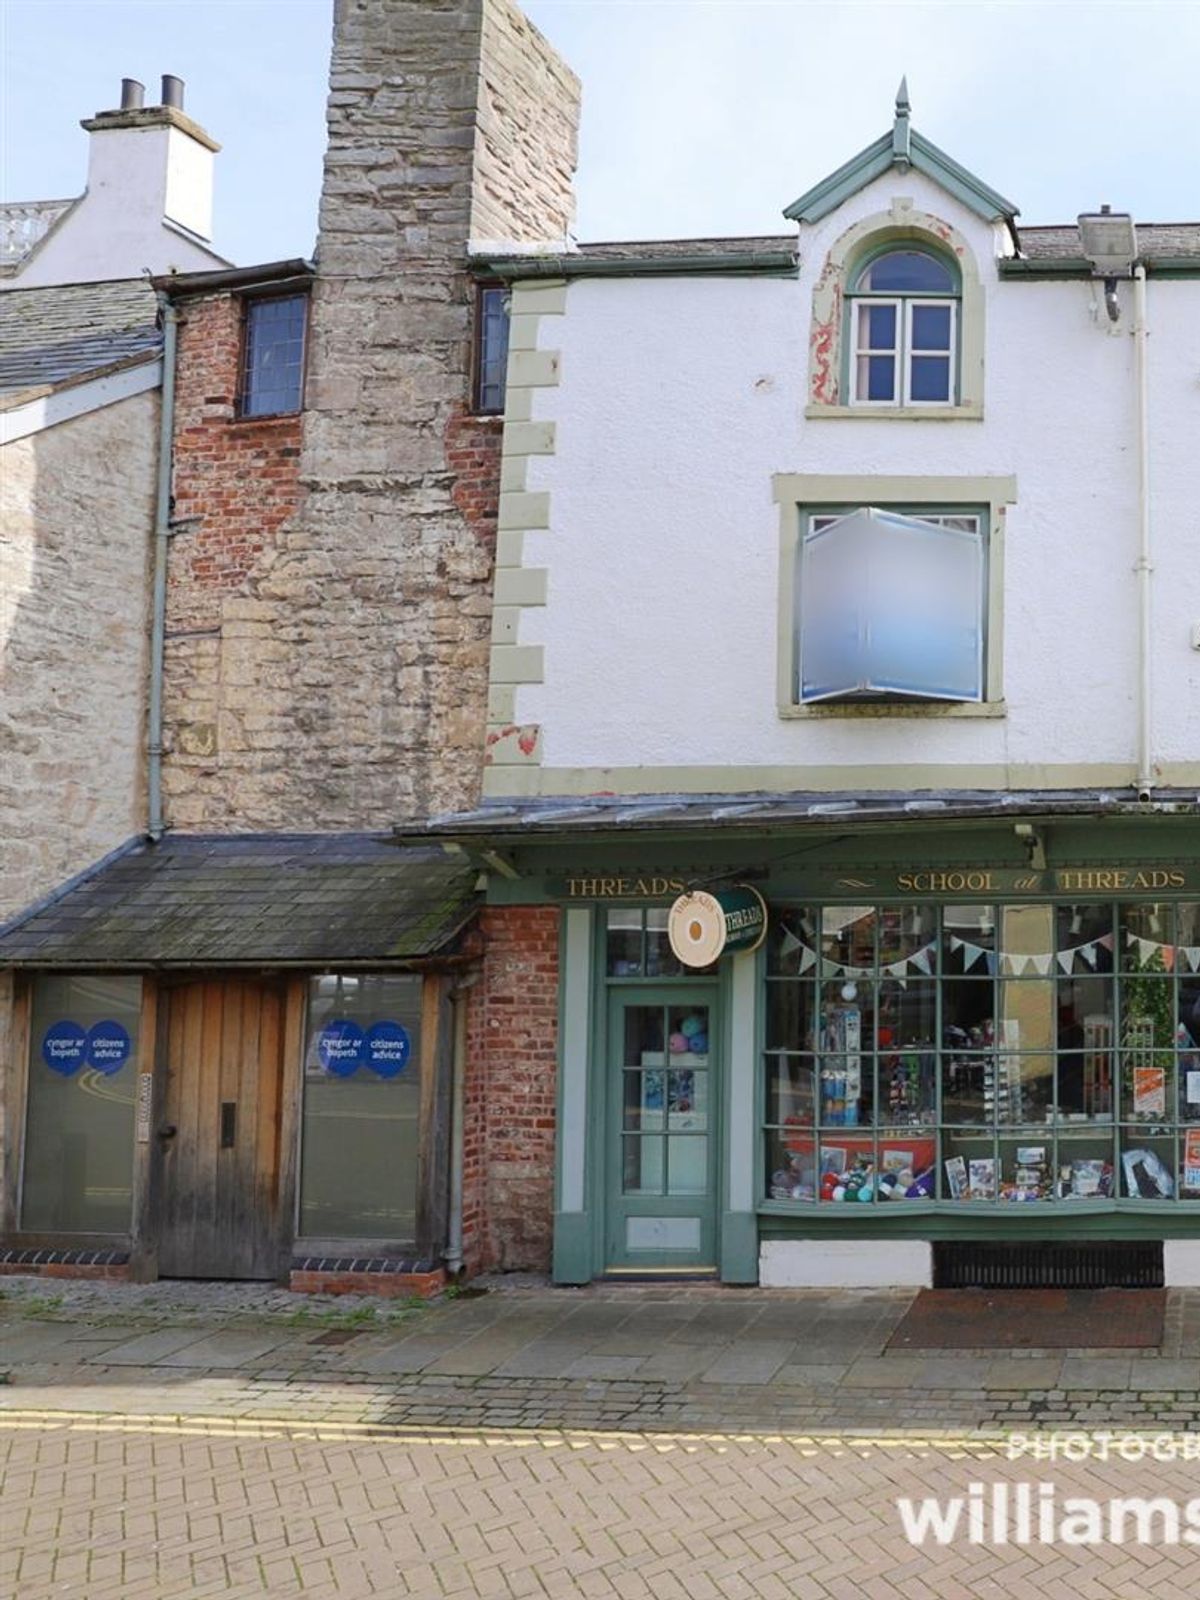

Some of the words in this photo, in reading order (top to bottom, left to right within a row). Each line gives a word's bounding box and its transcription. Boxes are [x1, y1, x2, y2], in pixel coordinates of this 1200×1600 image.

[898, 872, 1000, 891] SCHOOL
[1014, 874, 1038, 891] at
[1060, 871, 1185, 890] THREADS
[566, 878, 685, 896] THREADS
[725, 905, 762, 931] THREADS
[93, 1038, 125, 1048] citizens
[371, 1038, 404, 1049] citizens
[94, 1049, 122, 1058] advice
[372, 1049, 401, 1059] advice
